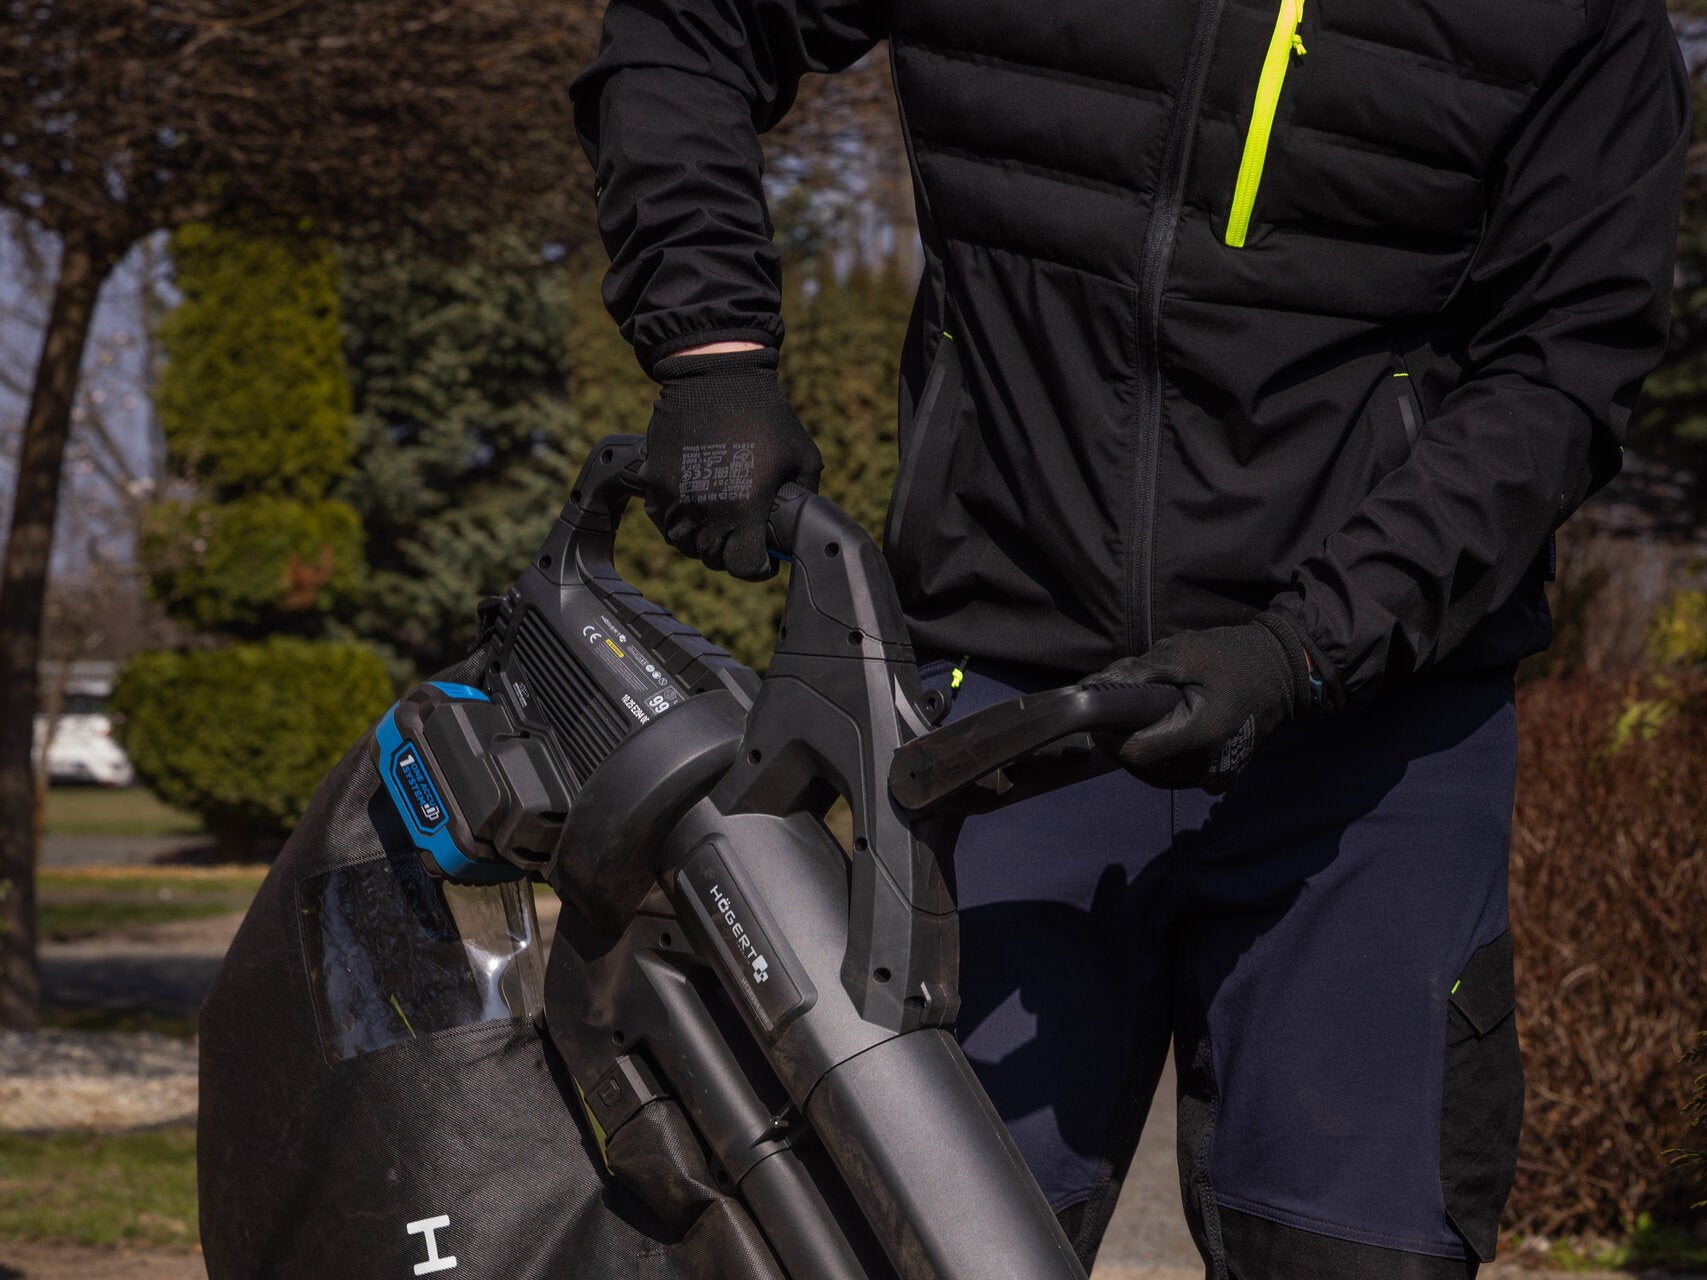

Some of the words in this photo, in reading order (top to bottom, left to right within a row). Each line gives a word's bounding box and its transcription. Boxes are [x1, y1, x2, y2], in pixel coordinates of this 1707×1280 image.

[649, 696, 670, 713] 99
[402, 766, 426, 806] SYSTEM
[411, 763, 424, 782] ONE
[422, 782, 437, 806] ACCU
[710, 885, 757, 959] HÖGERT
